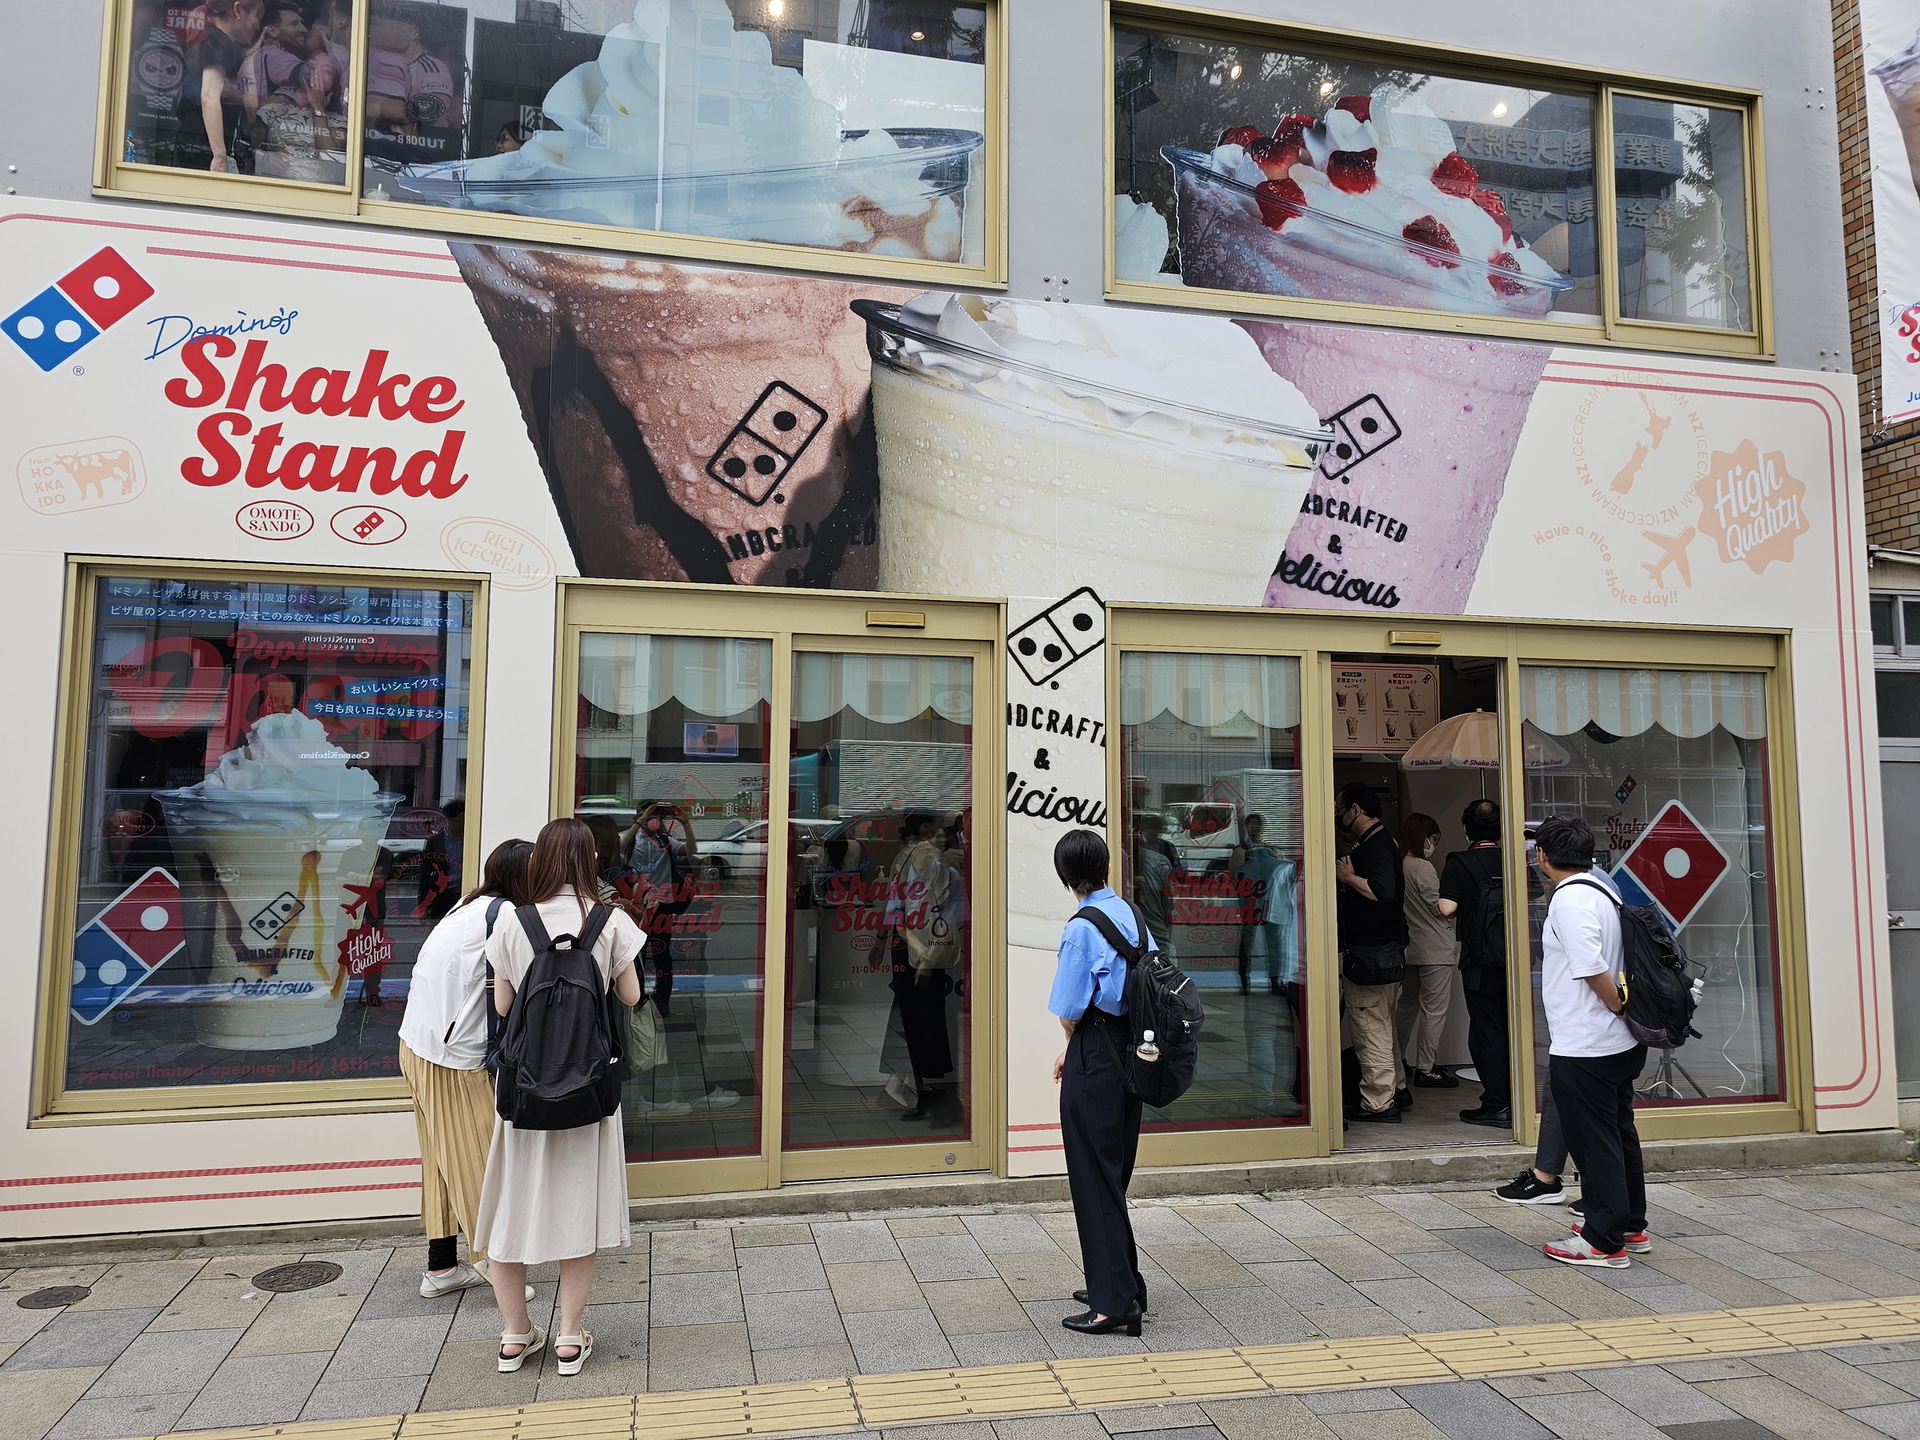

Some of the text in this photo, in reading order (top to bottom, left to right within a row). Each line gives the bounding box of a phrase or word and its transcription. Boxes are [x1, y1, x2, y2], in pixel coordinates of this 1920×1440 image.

[144, 307, 299, 360] Domino's
[164, 334, 466, 424] Shake
[27, 457, 52, 468] from
[180, 412, 469, 499] Stand
[30, 463, 54, 479] HO
[34, 478, 64, 493] KKA
[37, 493, 67, 508] IDO
[1714, 451, 1783, 528] High
[248, 519, 302, 533] SANDO
[249, 507, 301, 521] OMOTE
[1725, 494, 1799, 561] Quality
[482, 529, 525, 557] RICH
[1328, 534, 1342, 554] &
[452, 537, 540, 584] ICECREAM
[1533, 524, 1679, 607] Have a nice shake day!!
[354, 633, 442, 673] Shop
[350, 677, 445, 695] おいしいシェイクで、
[313, 703, 459, 720] 今日も良い日になりますように。
[1007, 702, 1107, 749] DCRAFT
[1034, 748, 1051, 771] &
[611, 872, 725, 903] Shake
[825, 873, 929, 904] Shake
[832, 902, 930, 932] Stand
[236, 948, 315, 963] HANDCRAFTED
[348, 927, 384, 958] High
[351, 944, 392, 975] Quality
[228, 977, 314, 998] Delicious
[79, 1067, 140, 1082] Special
[147, 1063, 204, 1078] limited
[286, 1058, 325, 1075] July
